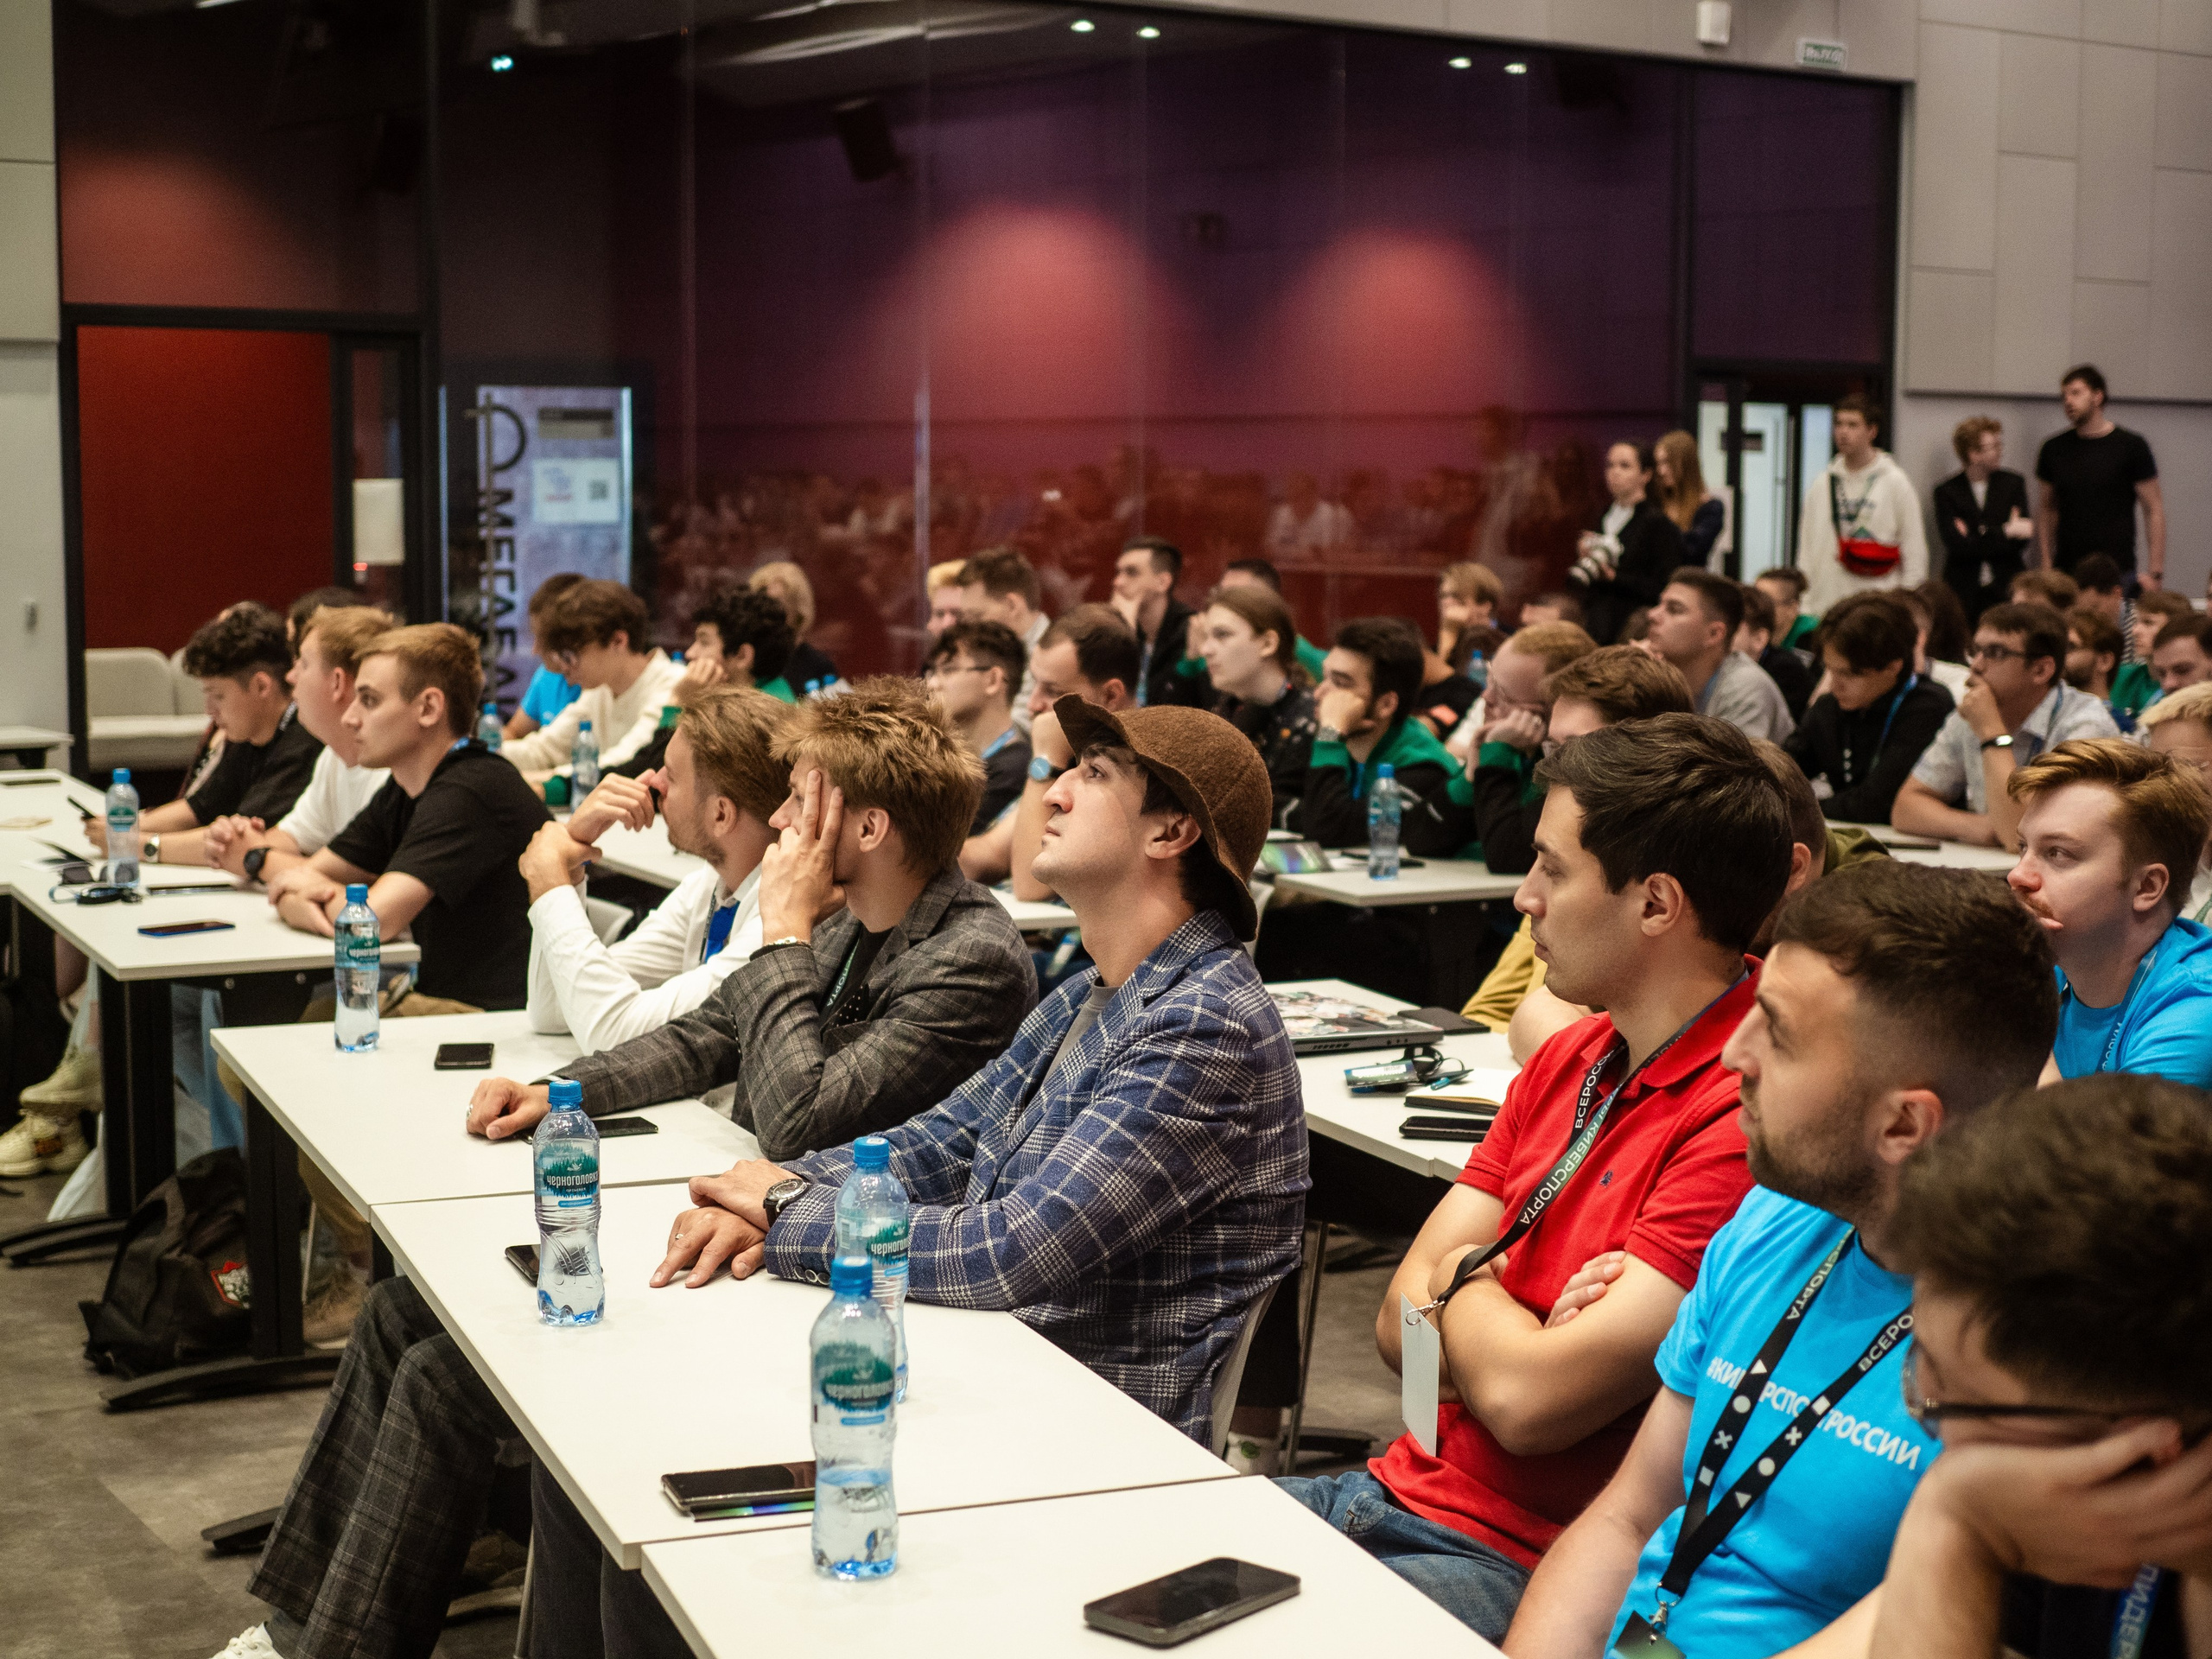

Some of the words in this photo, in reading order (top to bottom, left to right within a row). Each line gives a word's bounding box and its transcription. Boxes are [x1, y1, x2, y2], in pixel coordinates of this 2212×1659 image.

[1574, 1050, 1614, 1129] ВСЕРОСС
[1519, 1122, 1599, 1225] КИБЕРСПОРТА
[1858, 1314, 1914, 1371] ВСЕРО
